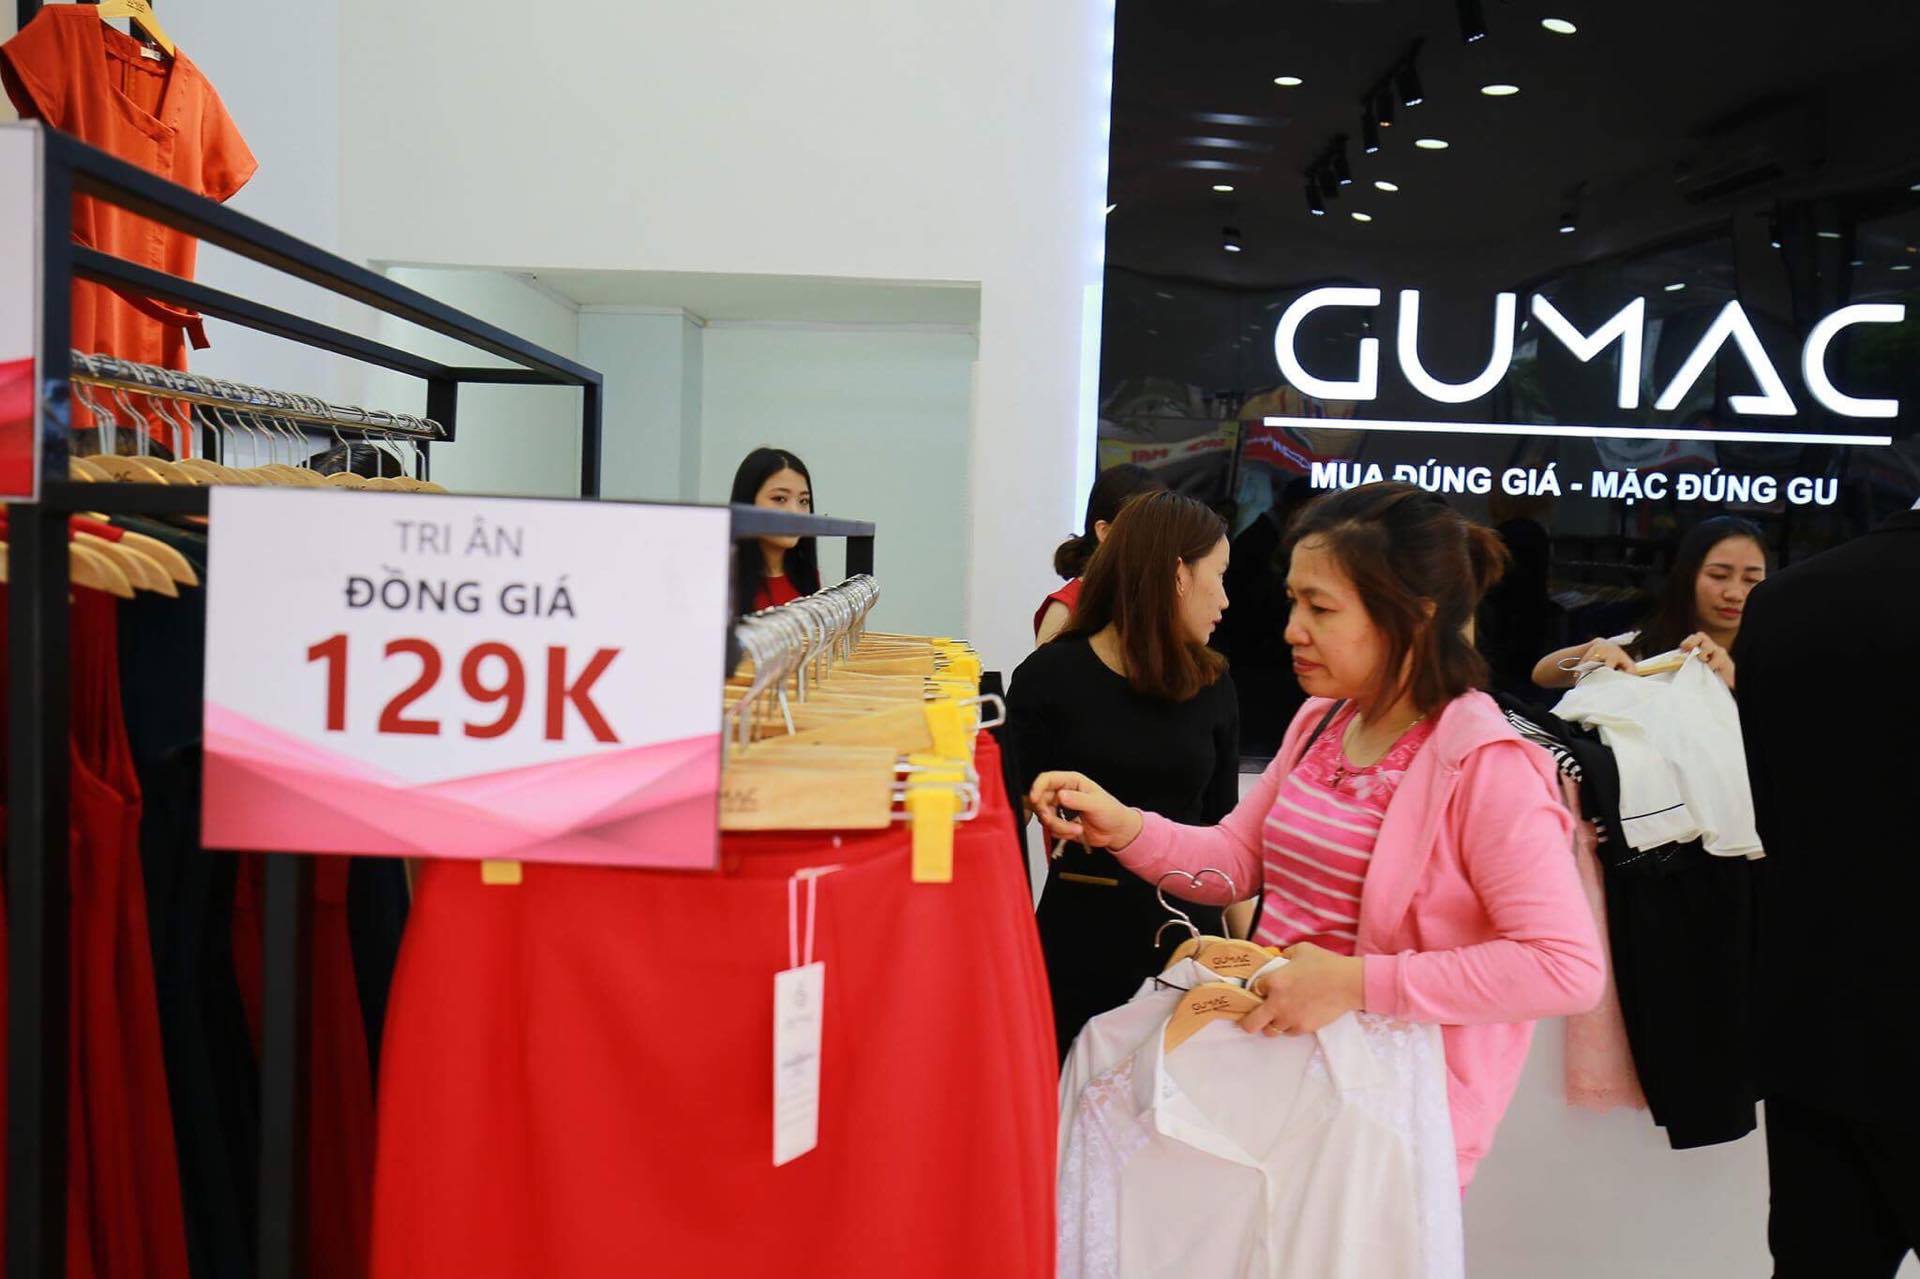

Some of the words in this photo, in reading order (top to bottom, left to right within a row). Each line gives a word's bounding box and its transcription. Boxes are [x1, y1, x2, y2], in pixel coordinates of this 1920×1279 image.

[1273, 286, 1906, 418] GUMAC
[1310, 461, 1384, 490] MUA
[1392, 458, 1492, 493] ĐÚNG
[1501, 462, 1562, 496] GIÁ
[1591, 468, 1668, 505] MẶC
[1676, 467, 1777, 503] ĐÚNG
[1787, 476, 1839, 505] GU
[394, 520, 452, 557] TRI
[465, 514, 525, 559] ÂN
[344, 564, 481, 615] ĐỒNG
[499, 573, 577, 619] GIÁ
[306, 632, 623, 744] 129K
